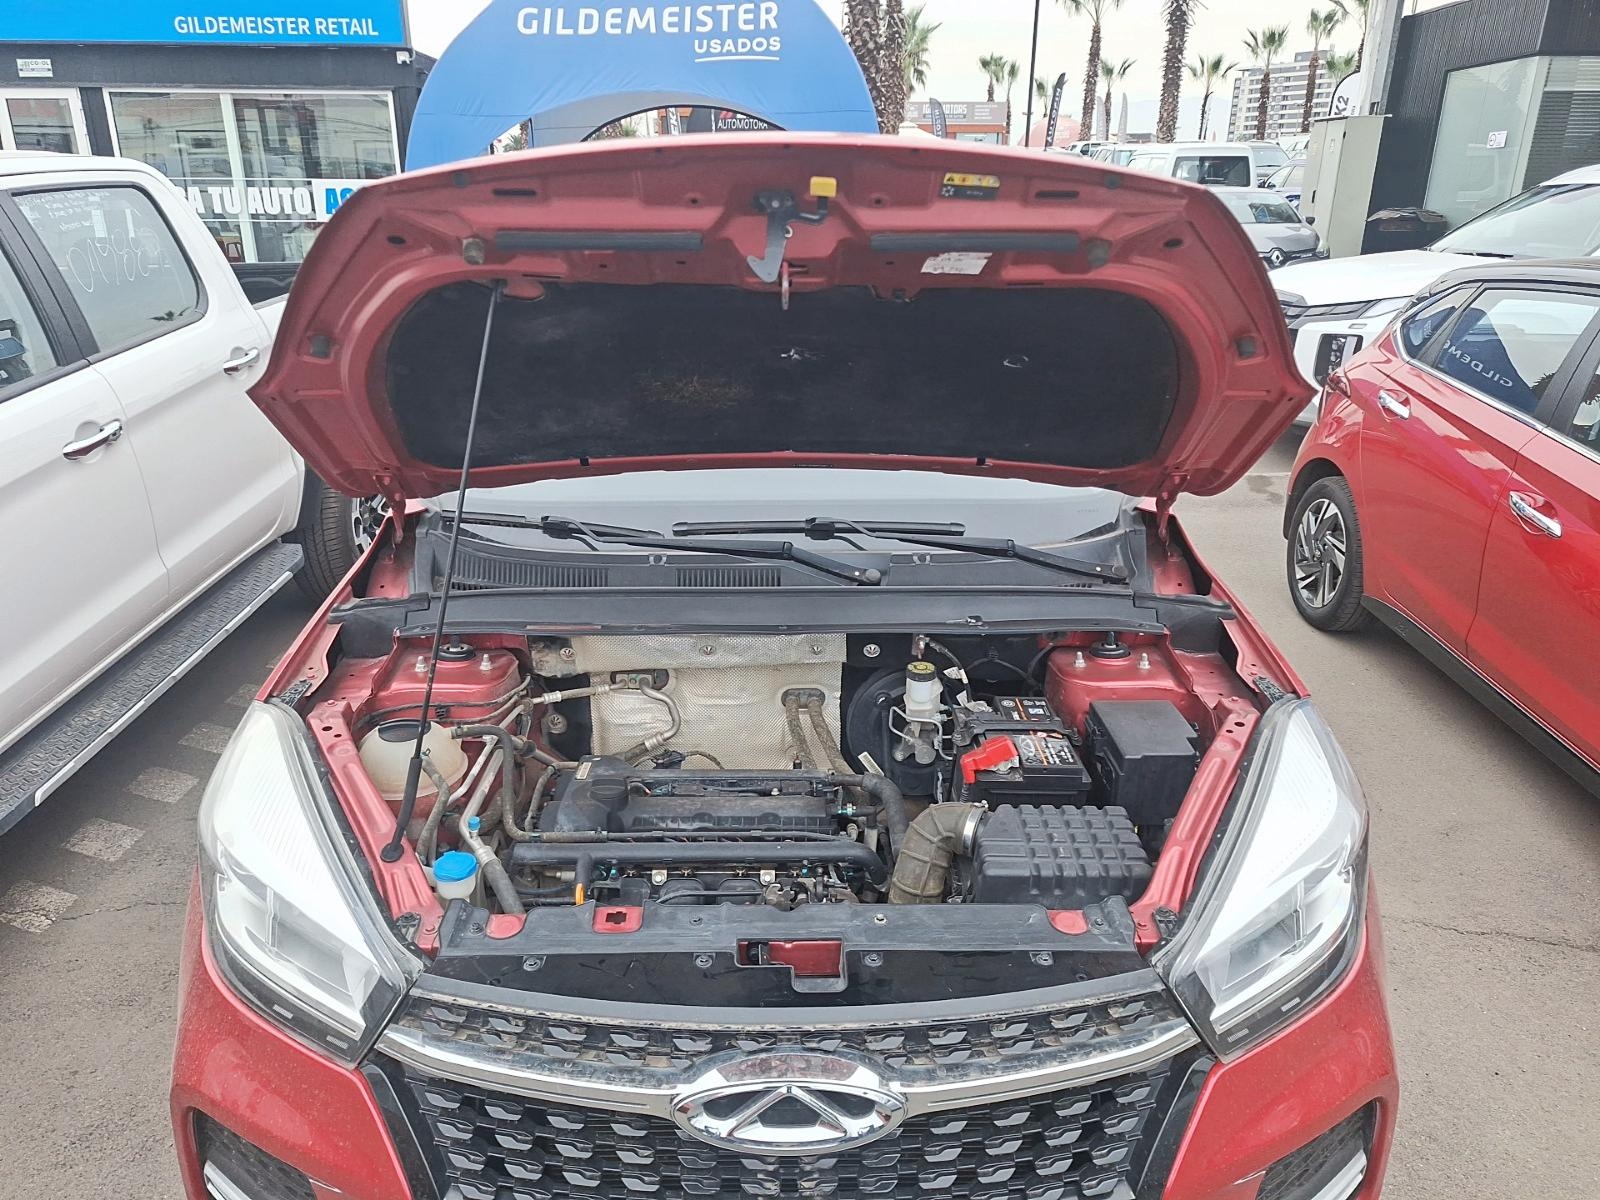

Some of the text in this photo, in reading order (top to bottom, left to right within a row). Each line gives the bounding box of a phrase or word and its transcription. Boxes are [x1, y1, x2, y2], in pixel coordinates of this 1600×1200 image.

[174, 16, 379, 36] GILDEMEISTER RETAIL
[517, 1, 779, 35] GILDEMEISTER
[694, 36, 781, 54] USADOS
[207, 187, 242, 214] TU
[248, 187, 312, 215] AUTO
